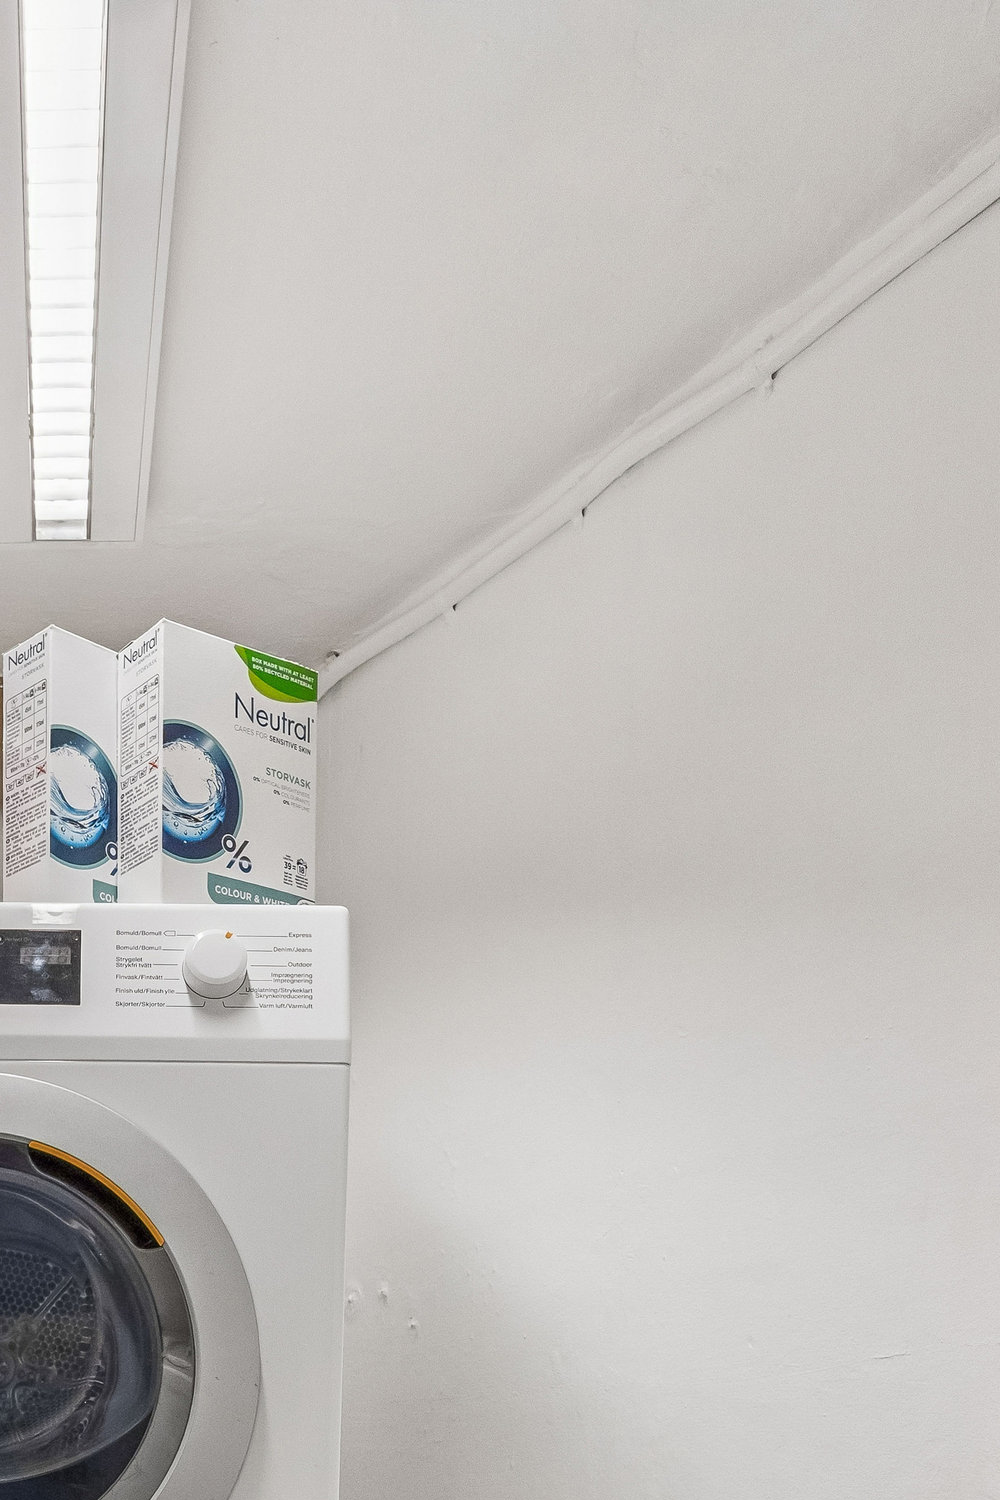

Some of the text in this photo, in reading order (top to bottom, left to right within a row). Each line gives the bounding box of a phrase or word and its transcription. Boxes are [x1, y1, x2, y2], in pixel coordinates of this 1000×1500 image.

[8, 633, 45, 671] Neutral
[123, 630, 158, 669] Neutral
[251, 656, 314, 683] BOX MADE WITH AT LEAST
[264, 667, 290, 681] RECYCLED
[290, 676, 314, 690] MATERIAL
[235, 692, 311, 743] Neutral
[233, 724, 311, 755] CARES FOR SENSITIVE SKIN
[265, 767, 311, 790] STORVASK
[283, 861, 292, 870] 39
[214, 884, 252, 901] COLOUR
[253, 894, 260, 904] &
[115, 929, 162, 937] Bomuld/Bomull
[288, 931, 312, 939] Express
